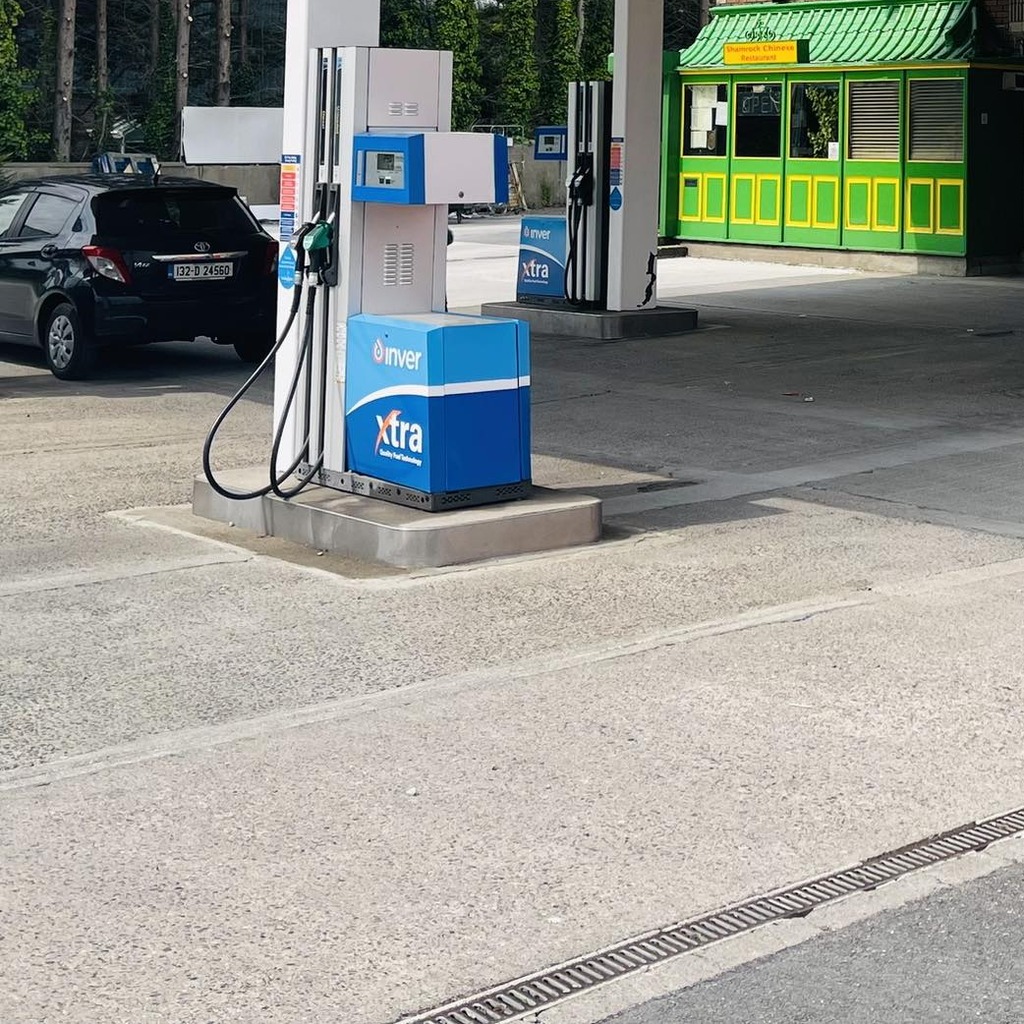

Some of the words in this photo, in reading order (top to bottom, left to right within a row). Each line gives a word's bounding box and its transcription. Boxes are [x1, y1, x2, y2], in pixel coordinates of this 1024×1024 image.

[726, 45, 761, 53] Shamrock
[763, 43, 795, 52] Chinese
[530, 228, 551, 240] inver
[176, 266, 200, 276] 132-D
[203, 264, 230, 276] 24560
[522, 259, 549, 279] xtra
[384, 345, 422, 370] inver
[375, 412, 423, 453] xtra
